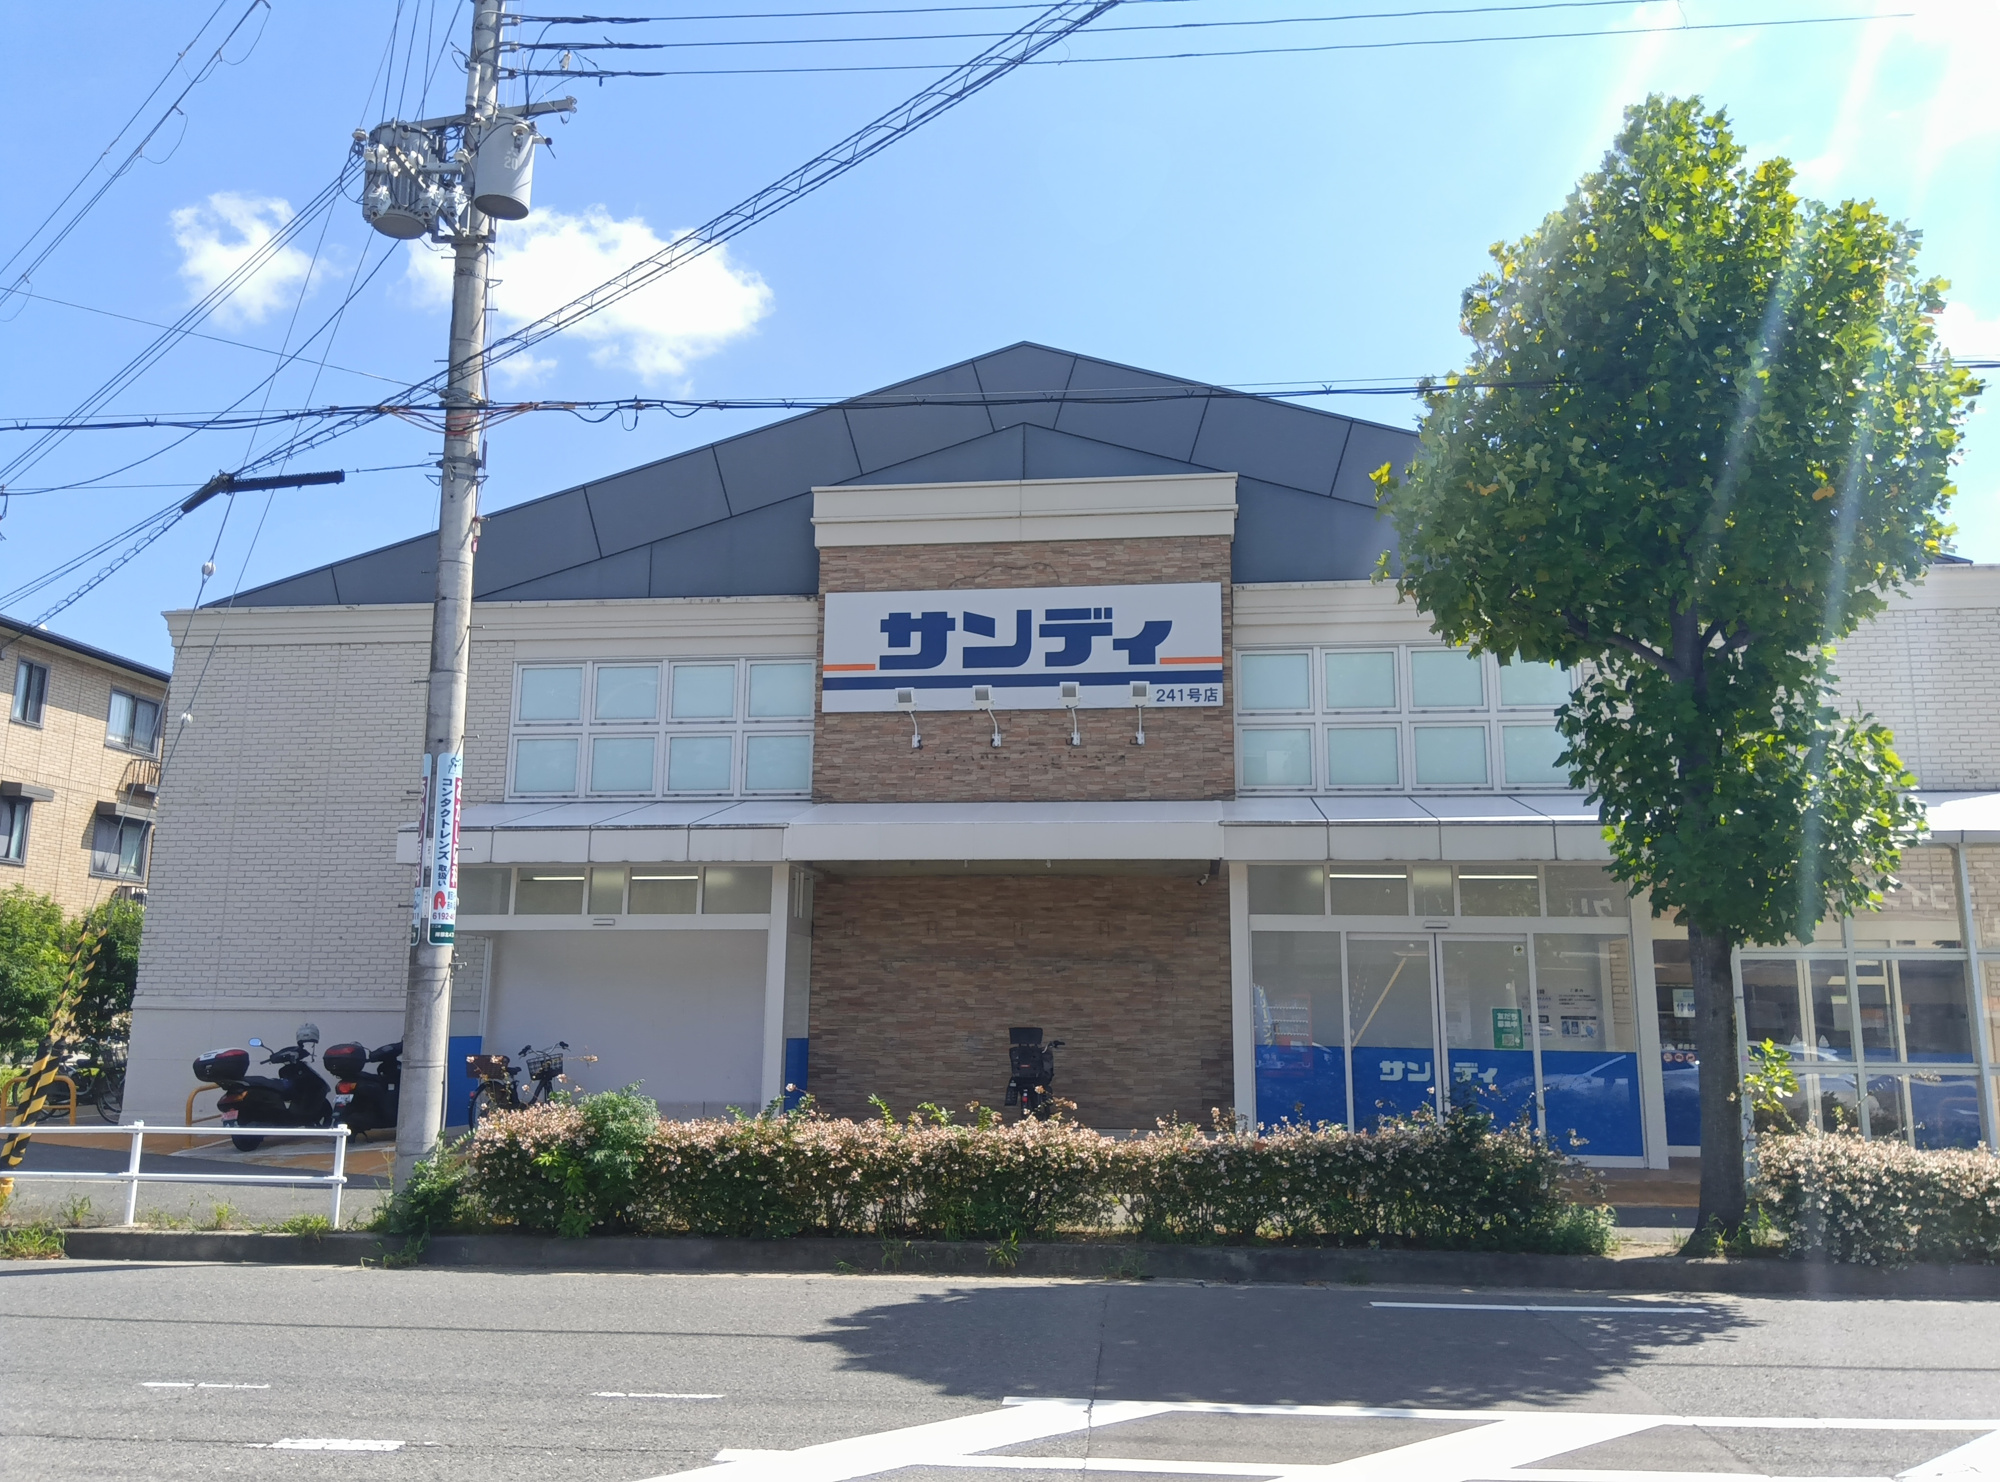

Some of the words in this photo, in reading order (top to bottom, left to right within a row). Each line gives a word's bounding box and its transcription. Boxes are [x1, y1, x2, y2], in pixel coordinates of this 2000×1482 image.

[879, 606, 1173, 670] サンディ
[1156, 687, 1218, 702] 241号店
[437, 778, 453, 861] コンタクトレンズ
